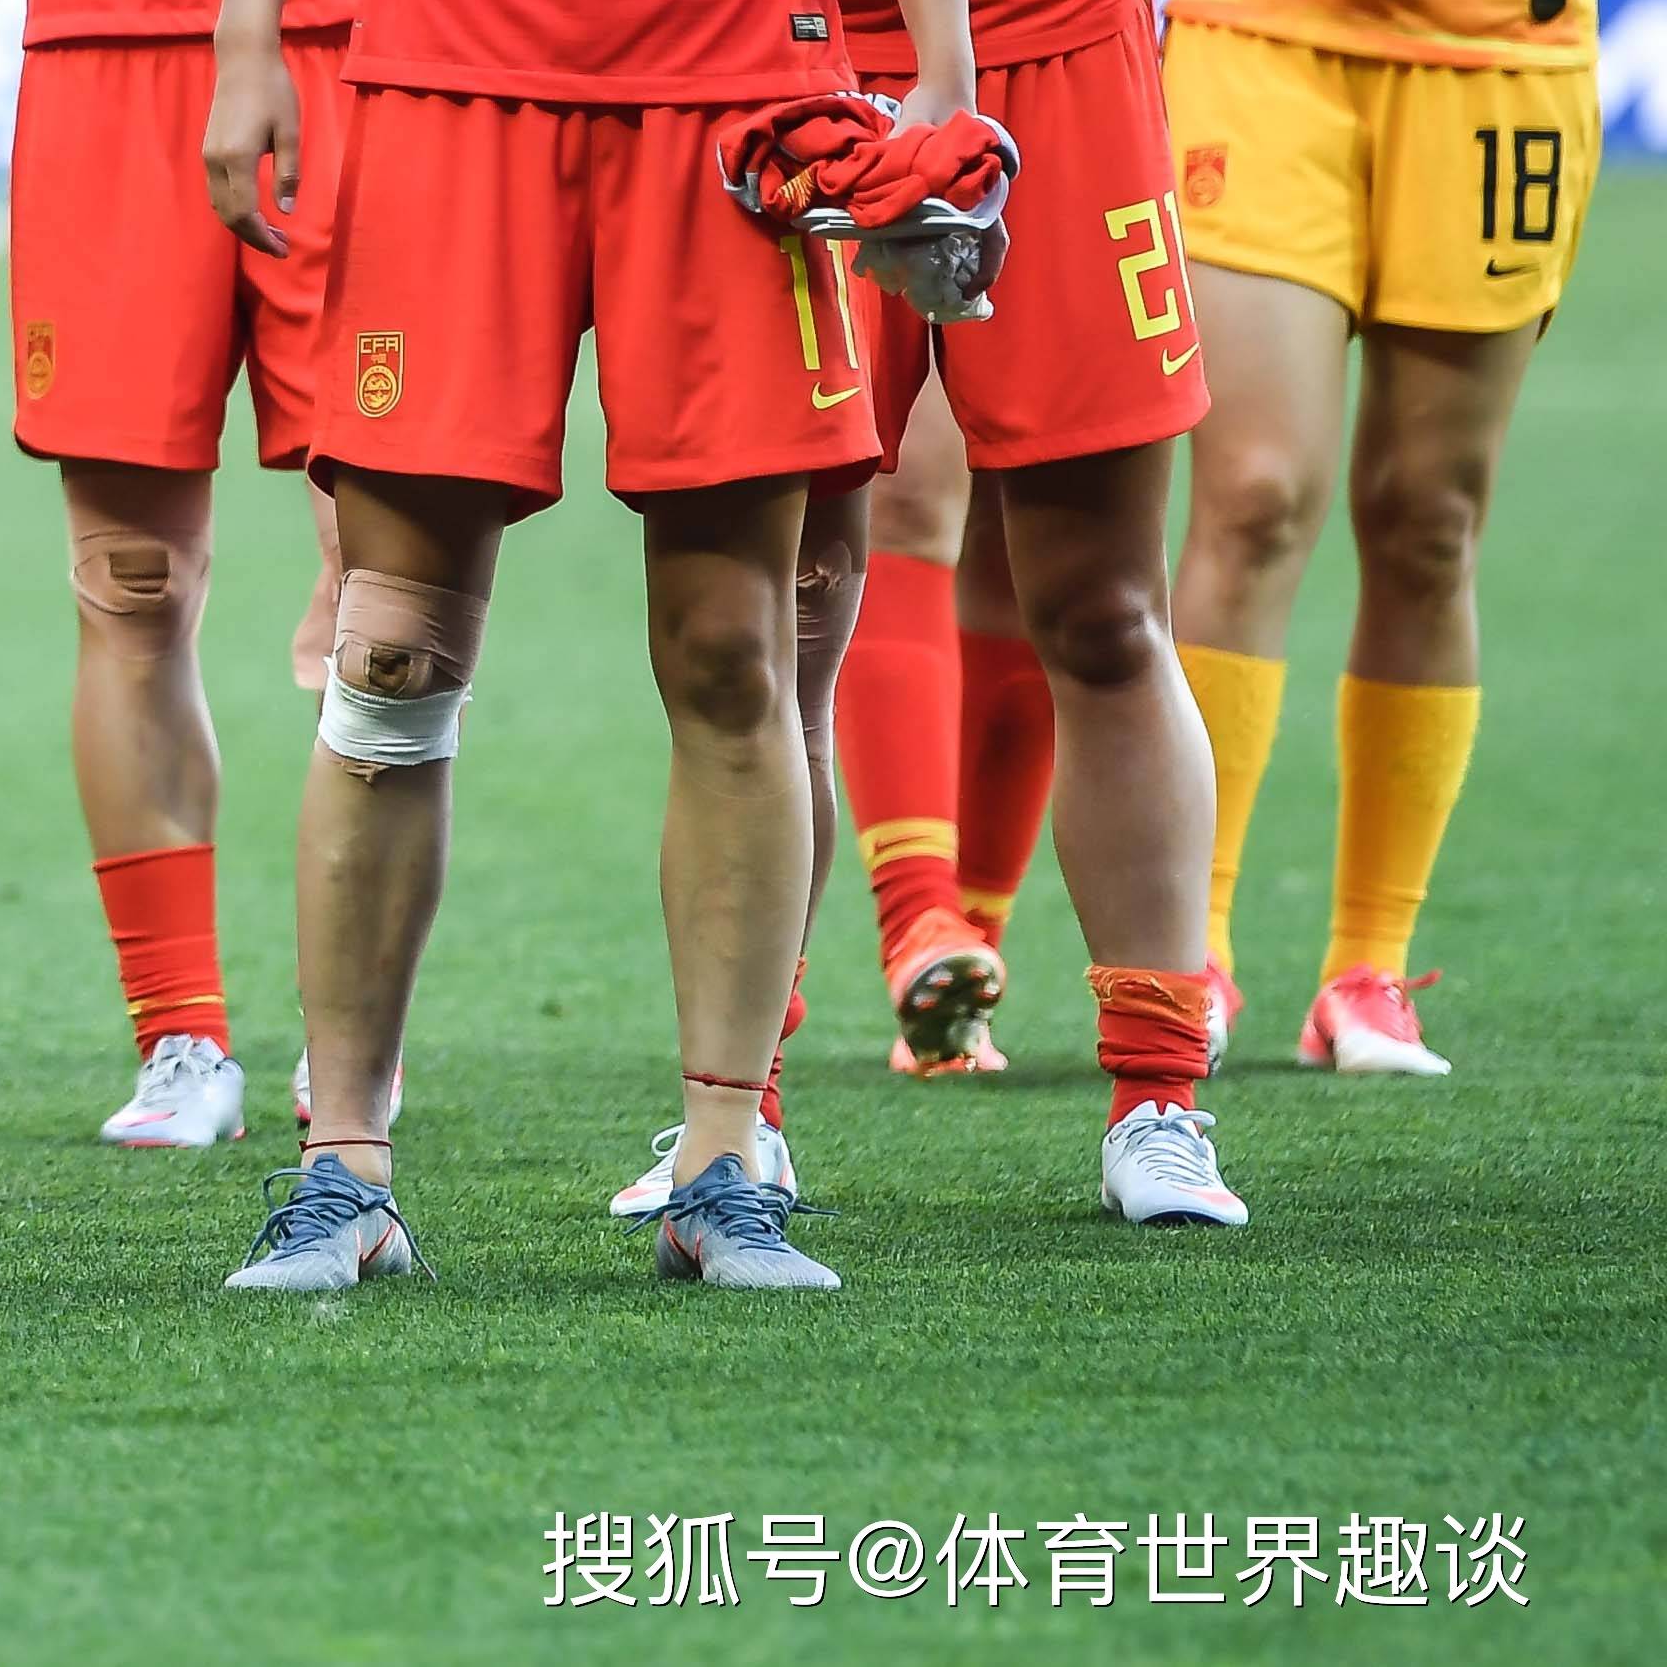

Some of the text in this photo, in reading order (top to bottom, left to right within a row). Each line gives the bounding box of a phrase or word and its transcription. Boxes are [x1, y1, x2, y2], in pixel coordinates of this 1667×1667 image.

[1475, 127, 1562, 242] 18
[779, 235, 860, 370] 11
[1105, 190, 1196, 342] 21
[360, 337, 399, 354] CFA
